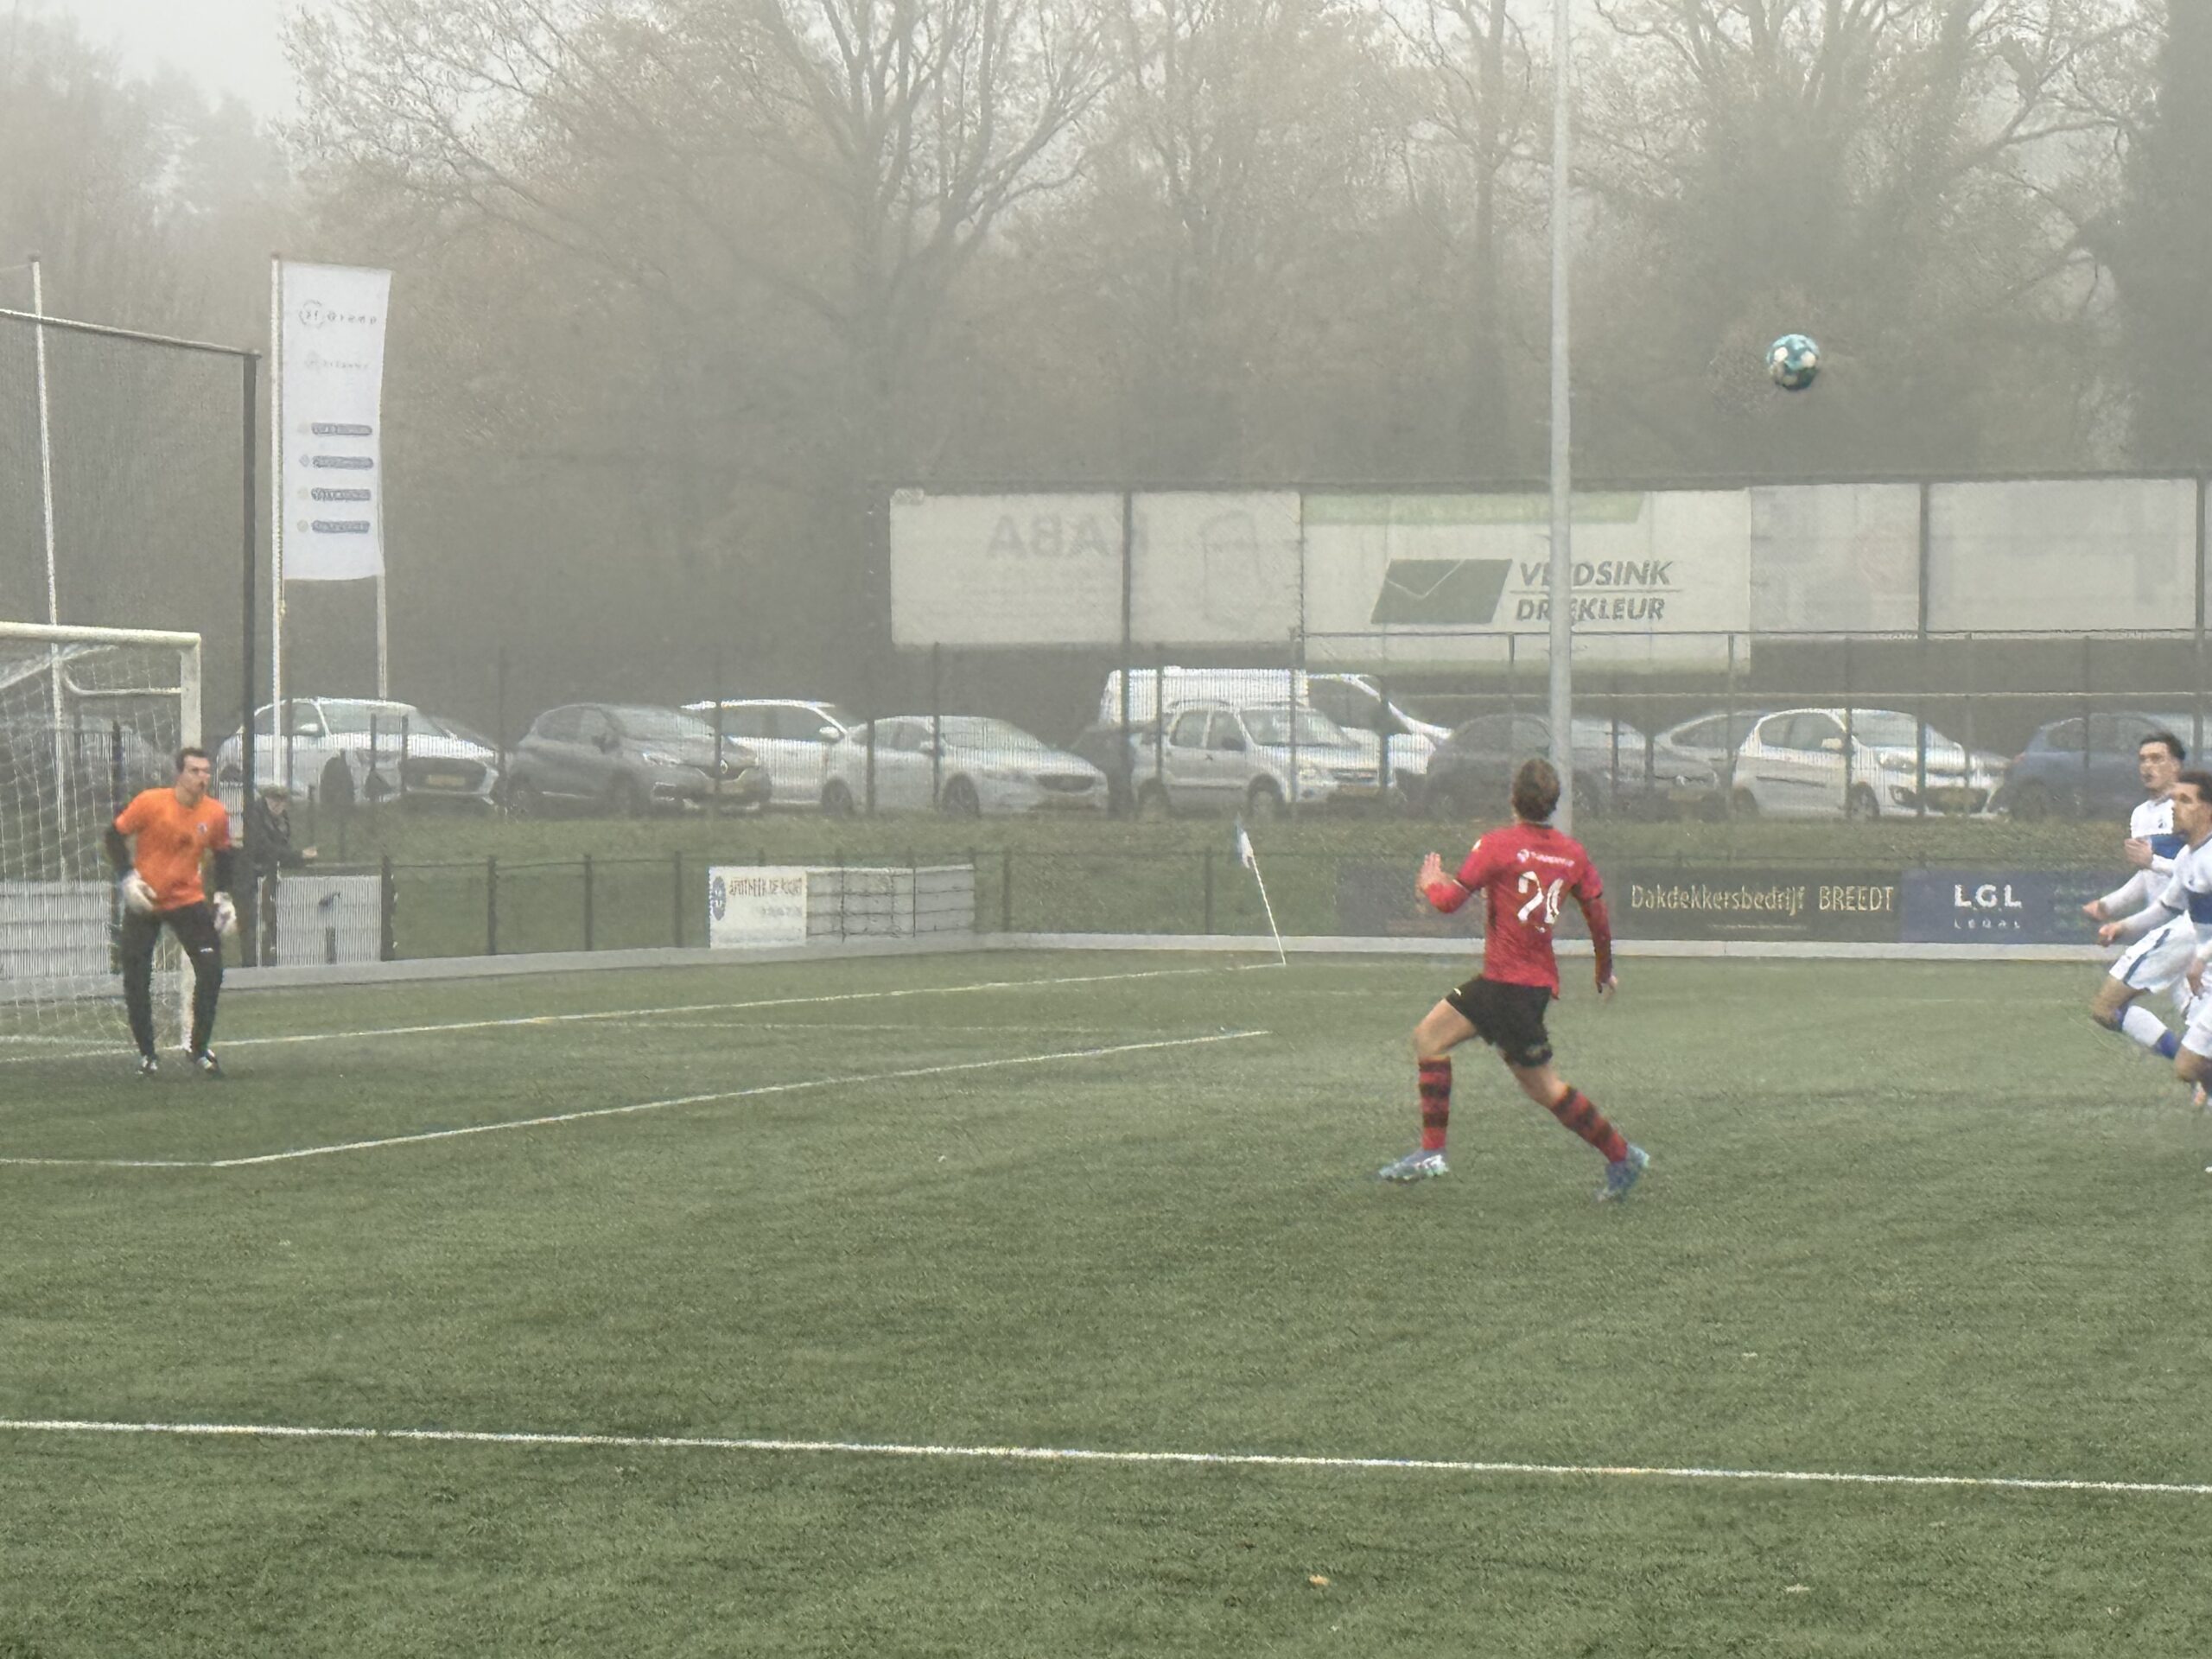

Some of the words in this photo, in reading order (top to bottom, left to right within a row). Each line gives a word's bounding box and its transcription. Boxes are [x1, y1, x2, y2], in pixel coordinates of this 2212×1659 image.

[1521, 559, 1674, 588] VDSINK
[1516, 596, 1665, 621] DRKLEUR
[1819, 885, 1895, 912] BREEDT
